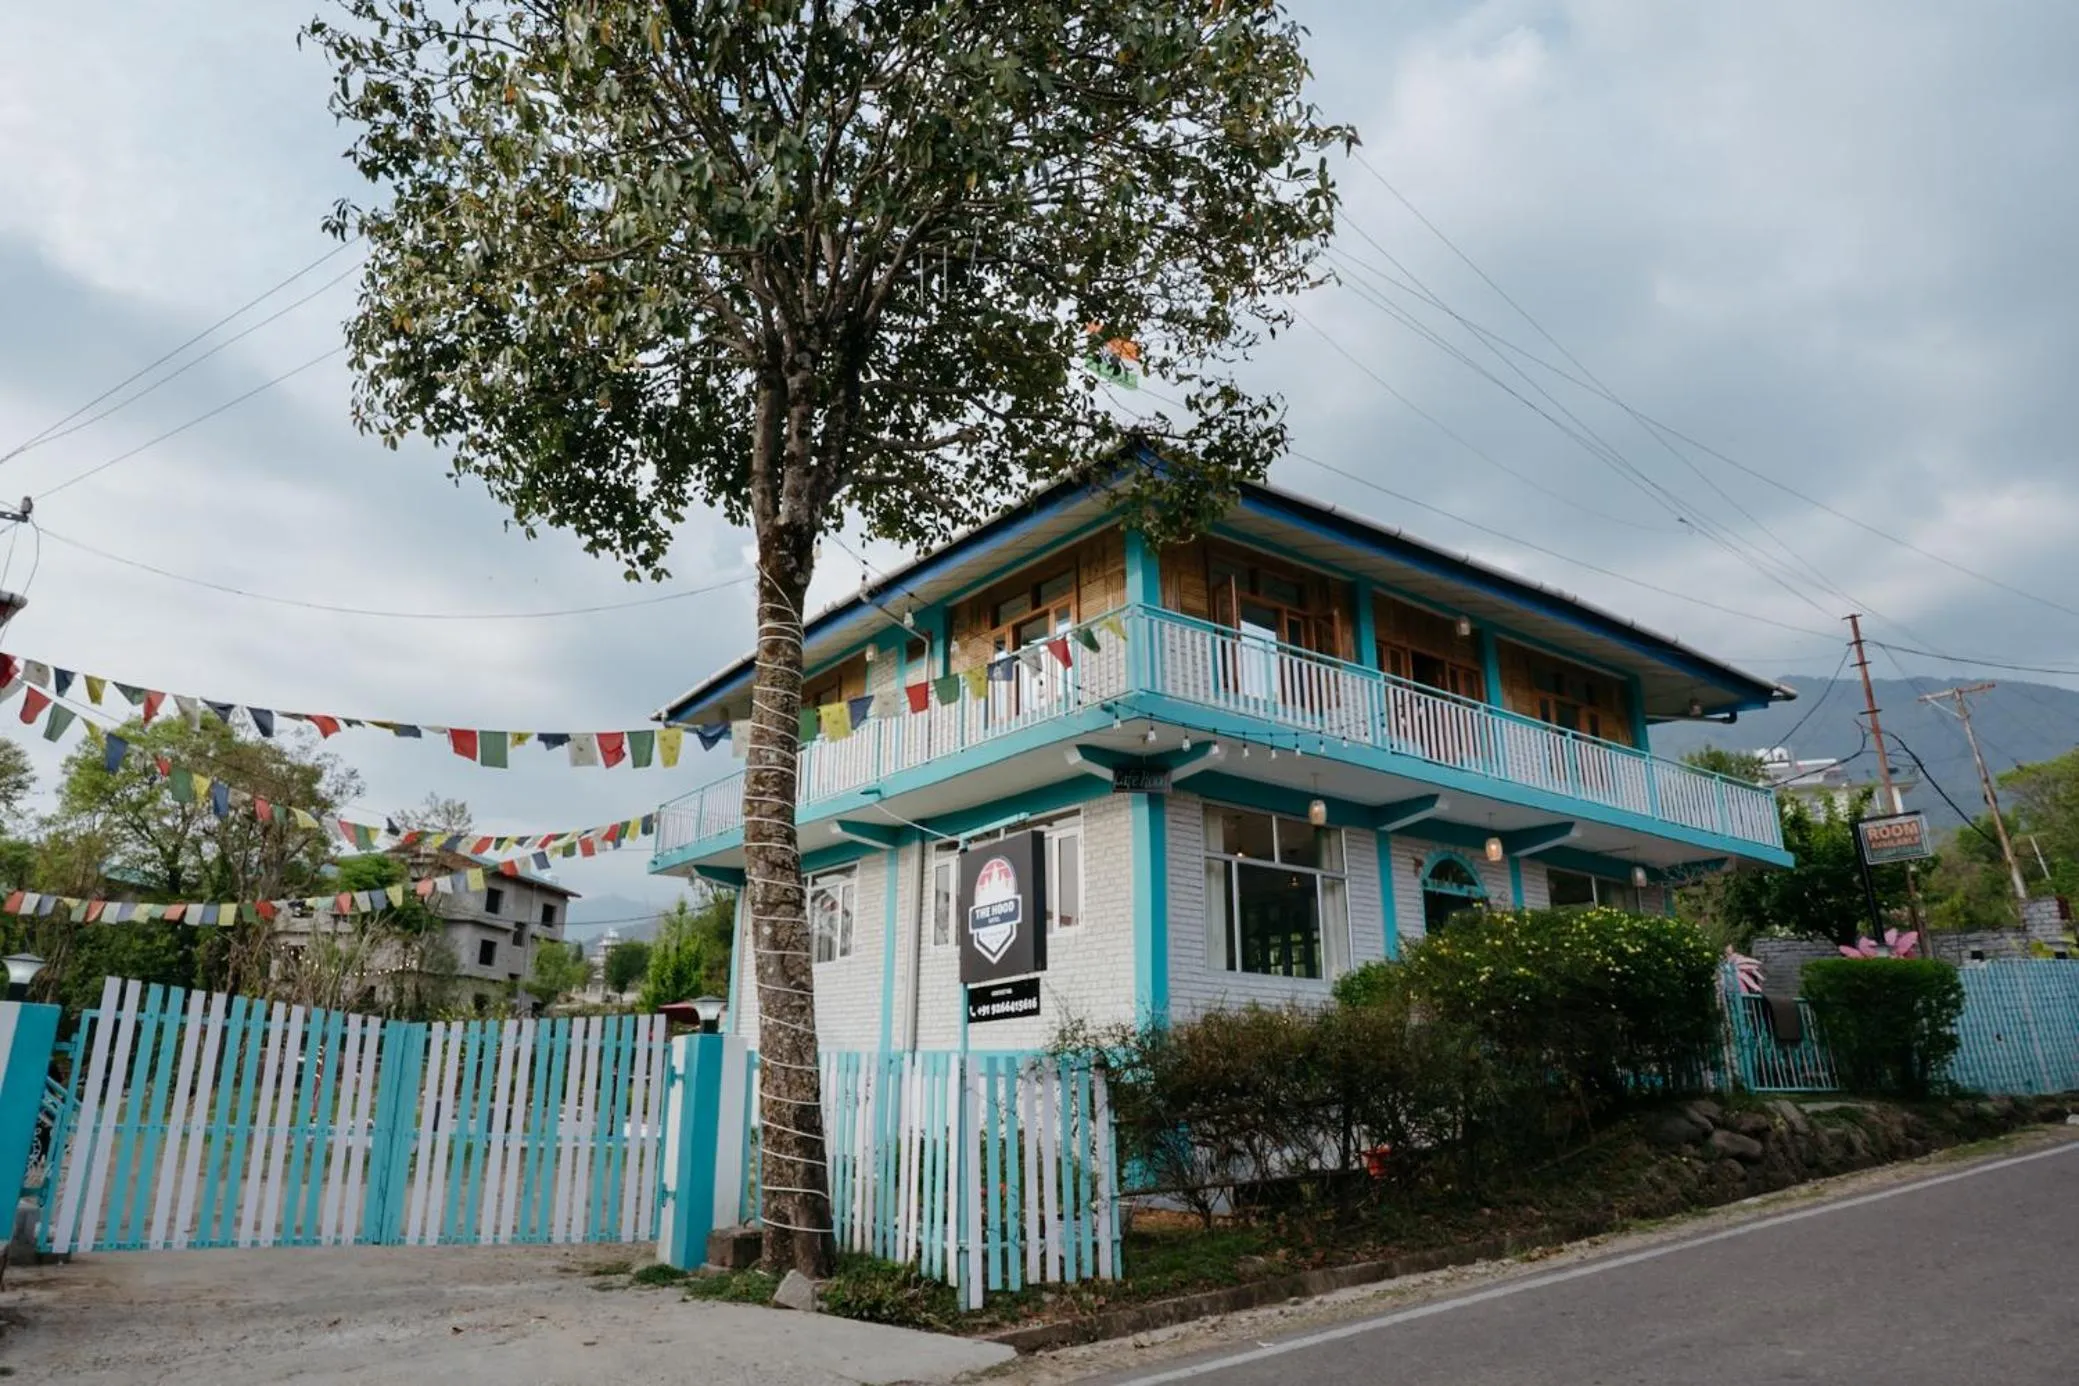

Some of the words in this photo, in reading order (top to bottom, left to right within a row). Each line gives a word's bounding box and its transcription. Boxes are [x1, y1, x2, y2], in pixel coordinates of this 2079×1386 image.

[1867, 822, 1918, 841] ROOM
[975, 906, 990, 920] THE
[991, 900, 1015, 916] HOOD
[977, 1004, 990, 1016] +91
